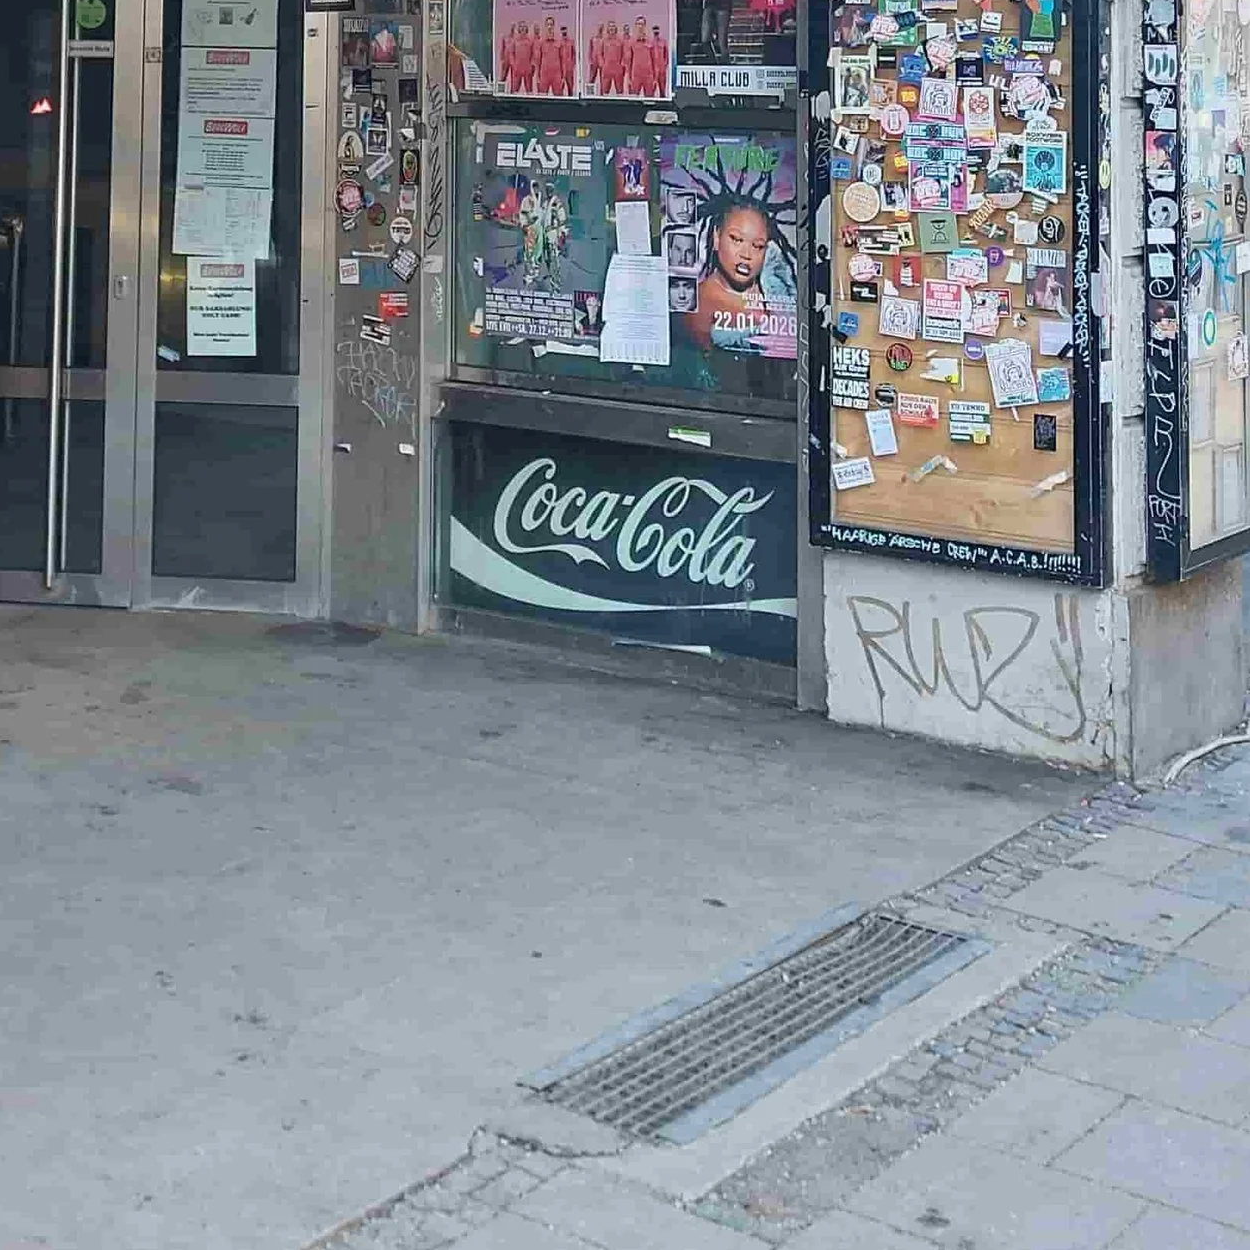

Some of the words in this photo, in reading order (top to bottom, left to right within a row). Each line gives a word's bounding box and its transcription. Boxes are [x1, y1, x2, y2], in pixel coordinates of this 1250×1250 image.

[680, 71, 716, 87] MILLA
[721, 71, 750, 87] CLUB
[496, 137, 592, 170] ELASTE
[493, 457, 776, 589] Coca-Cola
